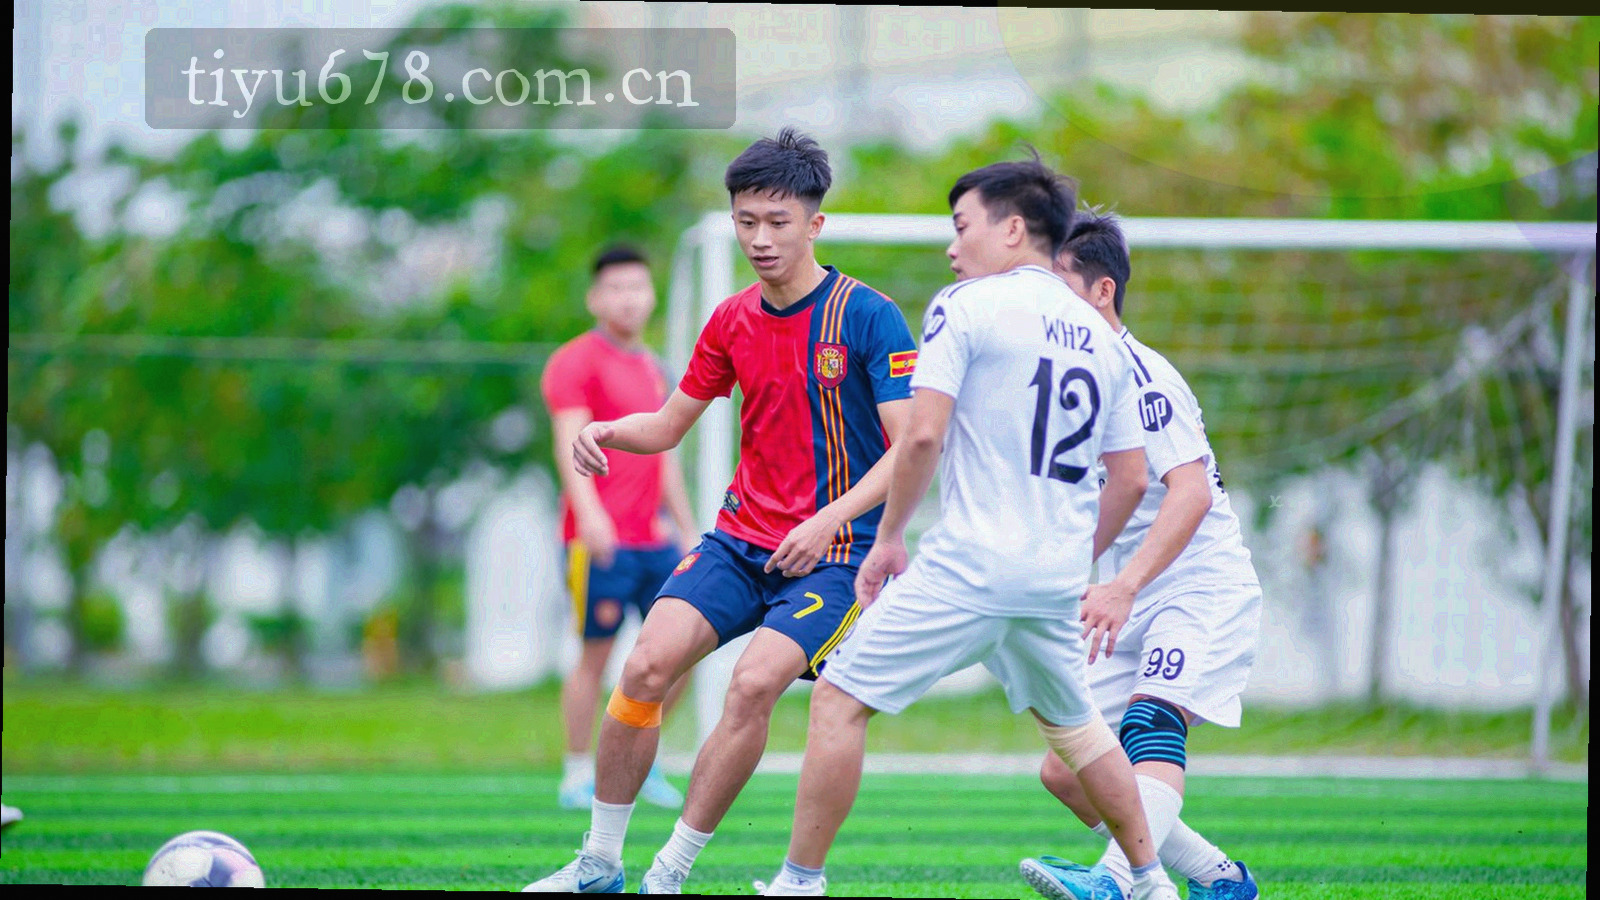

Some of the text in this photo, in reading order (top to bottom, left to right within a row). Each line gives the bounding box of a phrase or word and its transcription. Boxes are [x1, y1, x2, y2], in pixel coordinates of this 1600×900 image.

[1042, 315, 1094, 355] WH2
[1028, 357, 1100, 484] 12
[1139, 391, 1170, 432] hp
[792, 591, 824, 619] 7
[1143, 647, 1185, 680] 99
